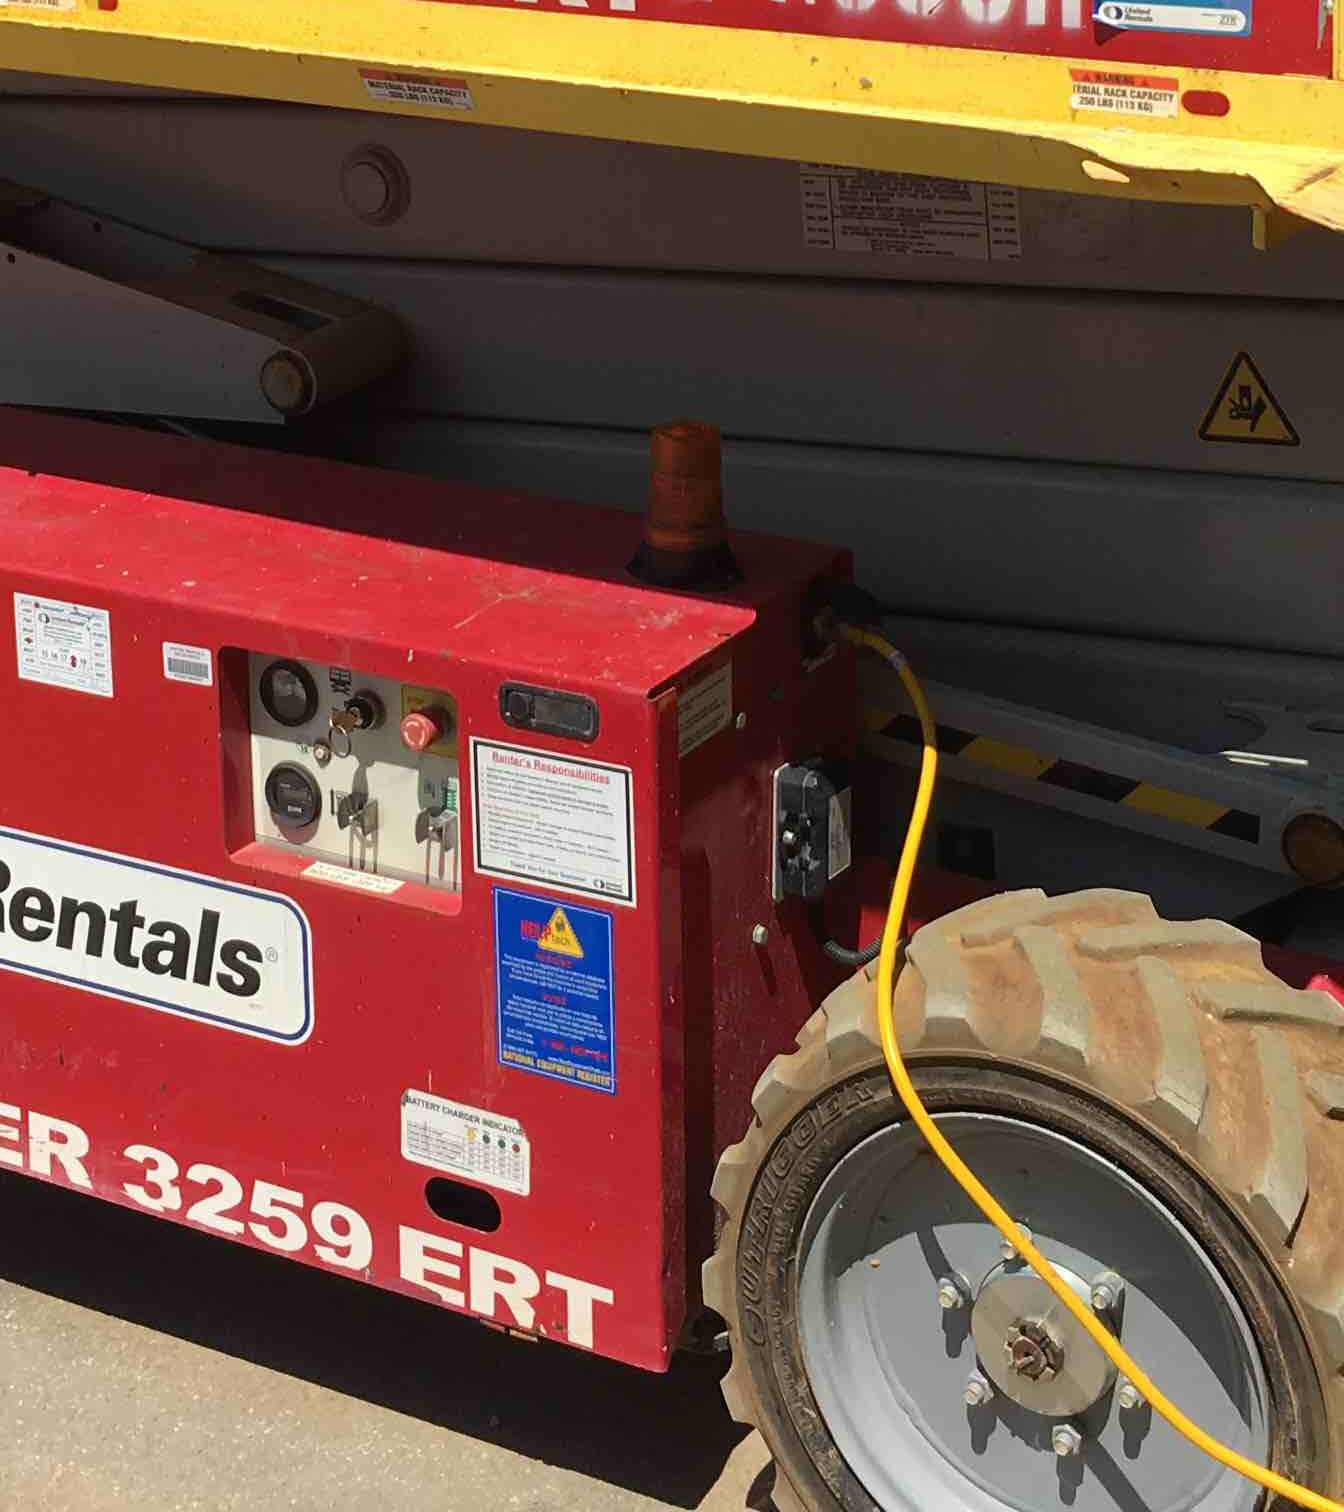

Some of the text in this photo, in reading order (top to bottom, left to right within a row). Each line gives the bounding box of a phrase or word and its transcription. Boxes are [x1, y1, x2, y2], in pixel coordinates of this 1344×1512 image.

[1097, 98, 1114, 108] LBS
[1103, 88, 1129, 99] RACK
[1130, 90, 1175, 103] CAPACITY
[406, 1094, 441, 1113] BATTERY
[442, 1105, 481, 1125] CHARGER
[122, 1144, 375, 1273] 3259
[399, 1223, 614, 1350] ERT
